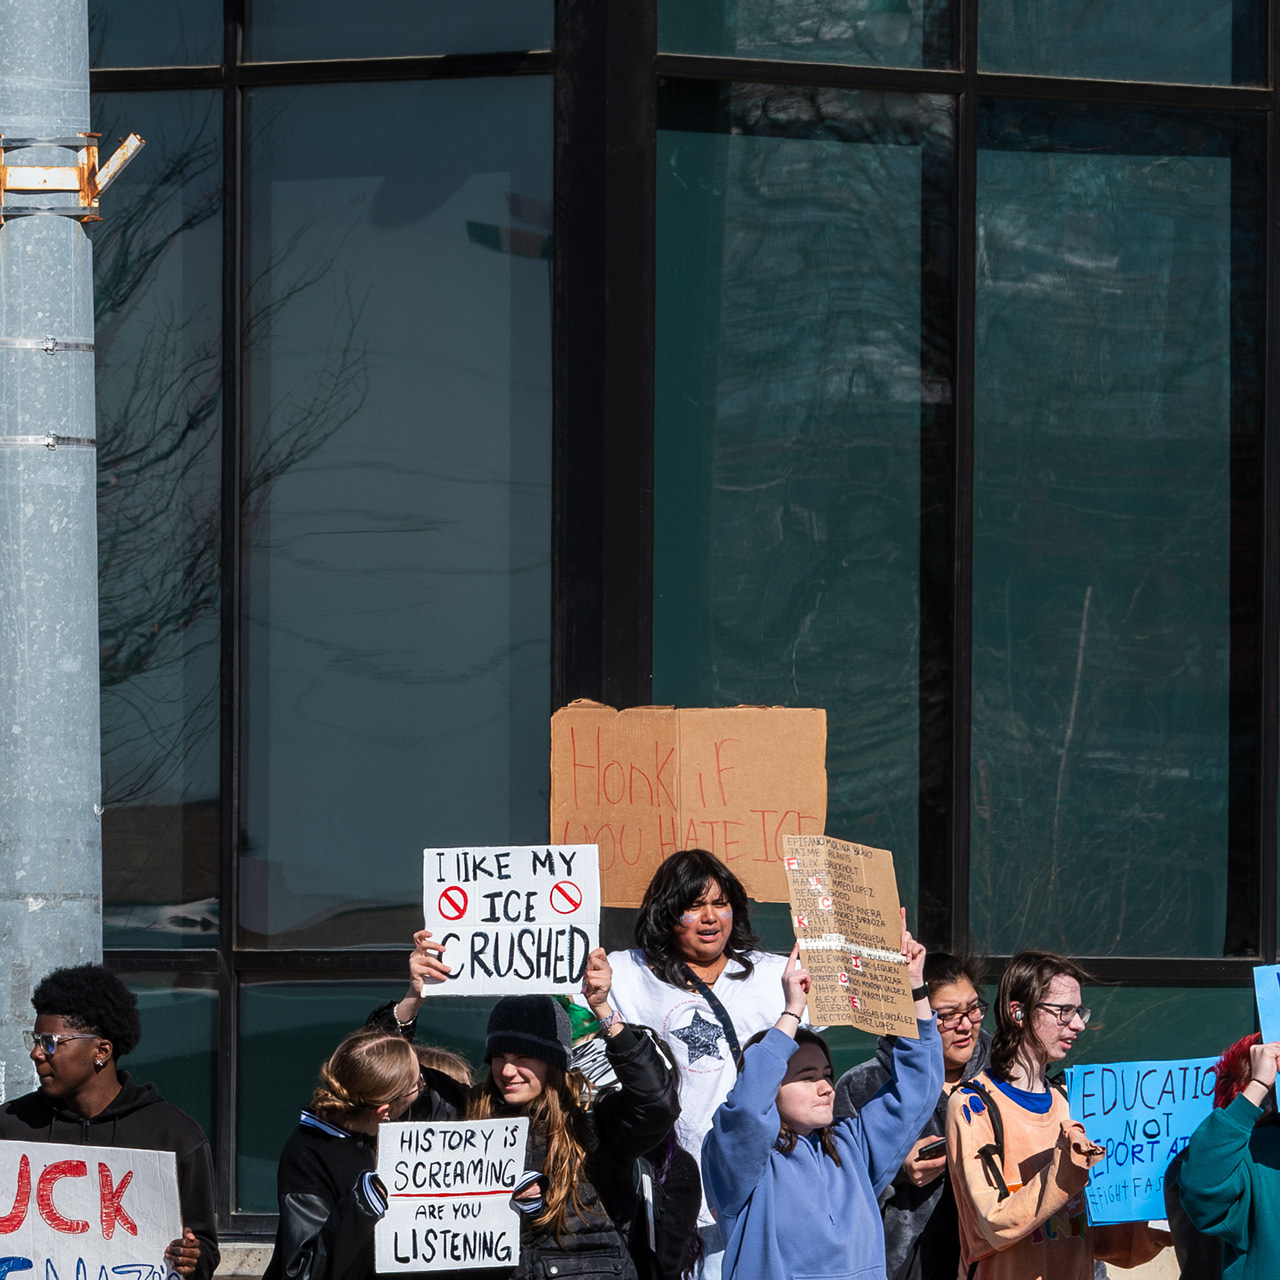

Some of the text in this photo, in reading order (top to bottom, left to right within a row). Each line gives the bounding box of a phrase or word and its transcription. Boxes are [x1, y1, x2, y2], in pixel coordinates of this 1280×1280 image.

[659, 814, 751, 864] HATE
[789, 847, 821, 858] JAIME
[436, 852, 446, 883] I
[531, 848, 577, 877] MY
[785, 856, 818, 871] FELIX
[833, 870, 854, 883] DAVIS
[795, 897, 819, 909] JOSE
[827, 888, 851, 902] GOOD
[481, 890, 538, 923] ICE
[796, 915, 860, 931] KEITH PORTER
[436, 923, 590, 984] CRUSHED
[805, 945, 833, 954] ELENA
[815, 995, 837, 1004] ALEX
[816, 1013, 853, 1022] HECTOR
[853, 1014, 875, 1028] LOPEZ
[1082, 1065, 1217, 1119] EDUCATIO
[1123, 1112, 1173, 1142] NOT
[400, 1127, 495, 1155] HISTORY
[394, 1158, 516, 1191] SCREAMING
[415, 1202, 482, 1220] ARE YOU
[394, 1228, 512, 1263] LISTENING
